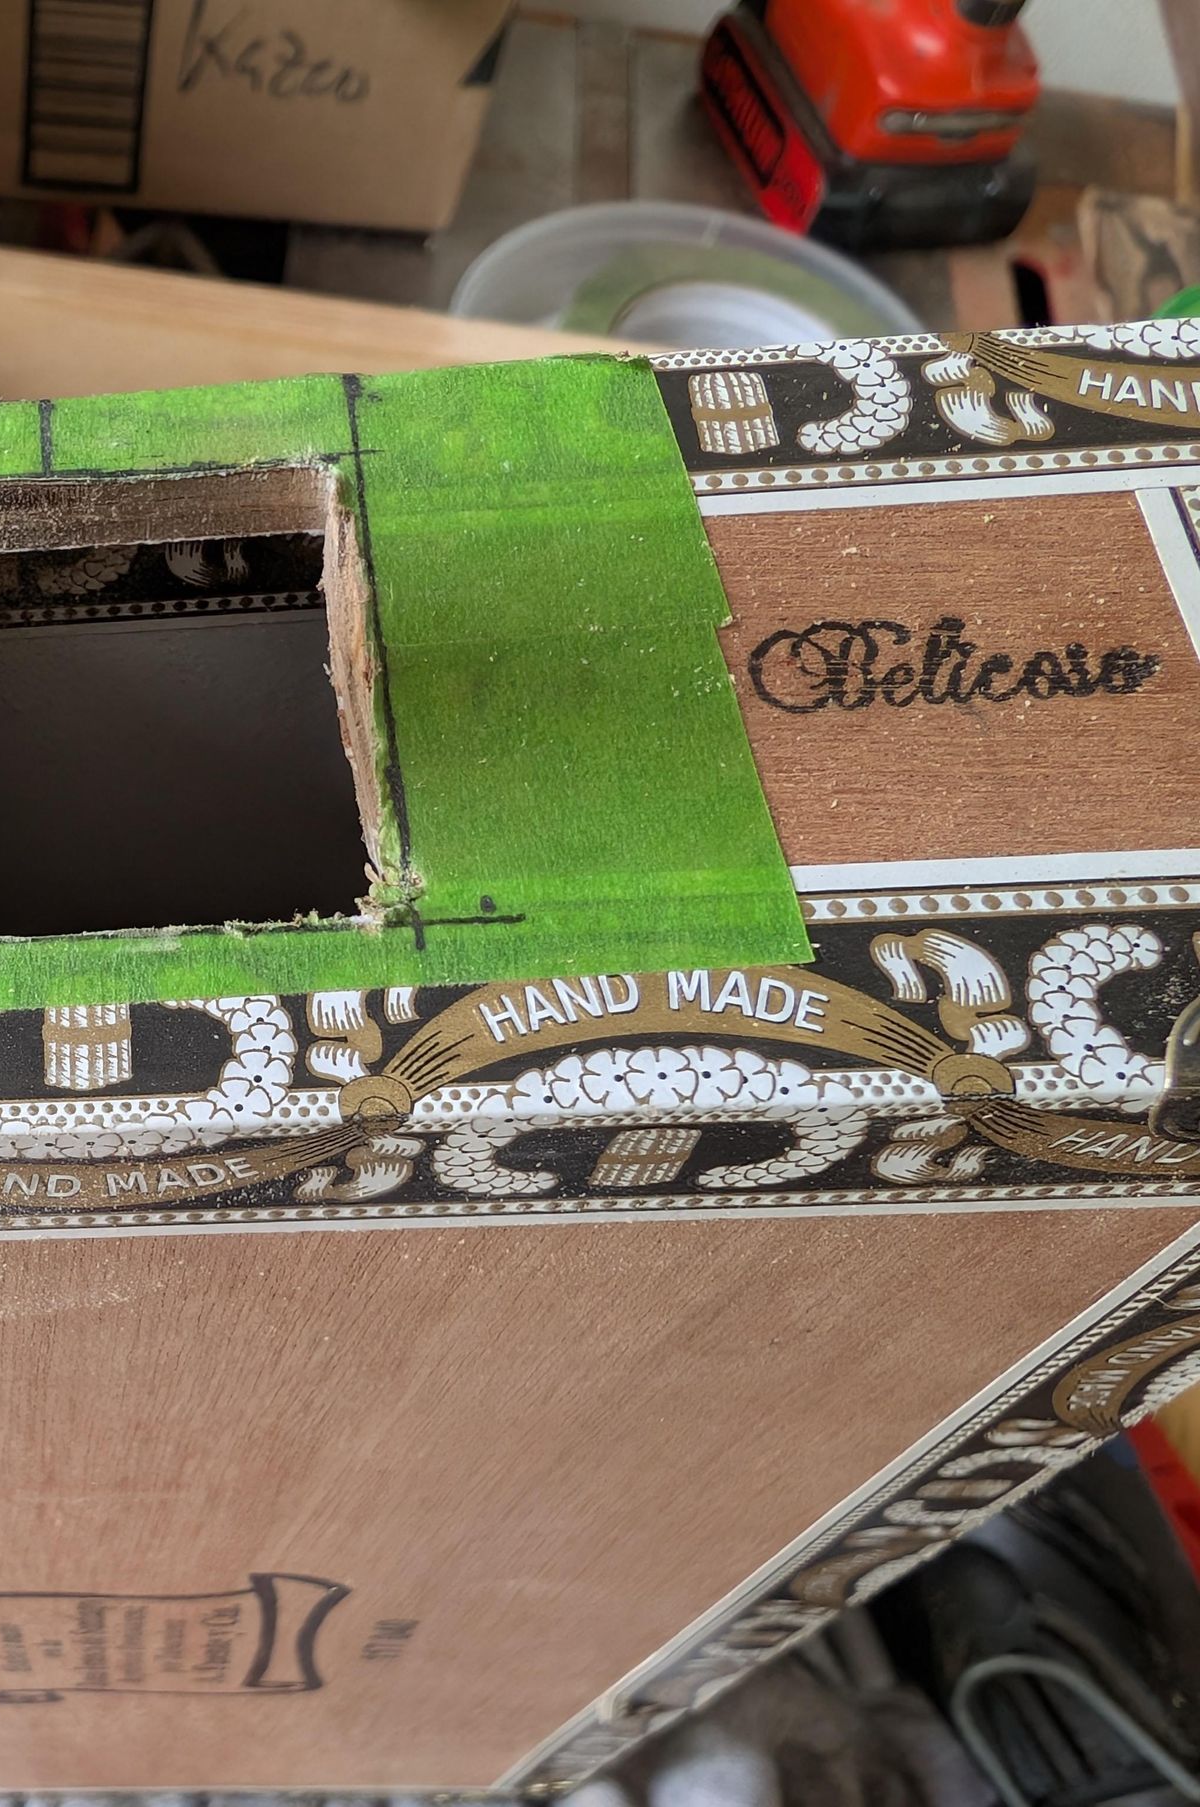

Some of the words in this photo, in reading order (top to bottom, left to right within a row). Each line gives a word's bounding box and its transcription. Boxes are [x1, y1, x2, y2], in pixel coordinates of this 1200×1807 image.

[1077, 368, 1200, 413] HAN
[479, 973, 640, 1043] HAND
[667, 969, 830, 1033] MADE
[107, 1156, 258, 1198] MADE
